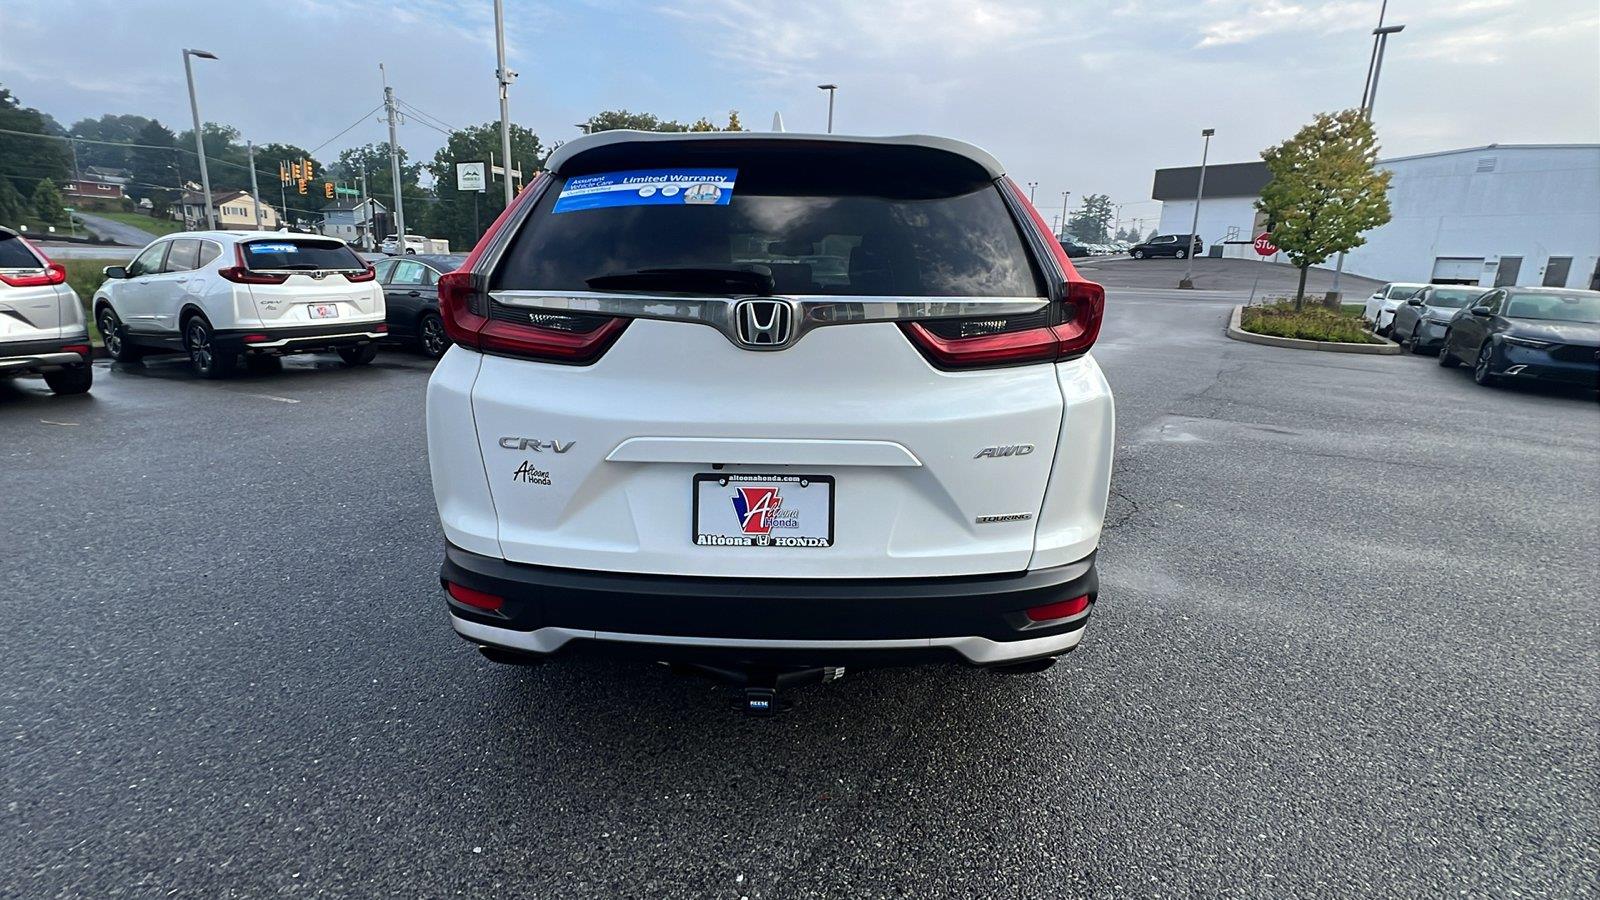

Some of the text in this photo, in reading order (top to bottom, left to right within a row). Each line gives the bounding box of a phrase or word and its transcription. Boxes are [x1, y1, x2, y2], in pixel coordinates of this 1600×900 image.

[572, 176, 605, 185] Assurant
[623, 175, 727, 185] Limited Warranty
[570, 182, 596, 190] Vehicle
[498, 437, 576, 453] CR-V
[973, 444, 1035, 459] AWD
[513, 460, 550, 482] Altoona
[528, 477, 552, 485] Honda
[742, 491, 799, 528] Altoona
[765, 517, 798, 528] Honda
[982, 514, 1030, 522] TOURING
[697, 534, 752, 546] Altoona
[775, 537, 830, 547] HONDA
